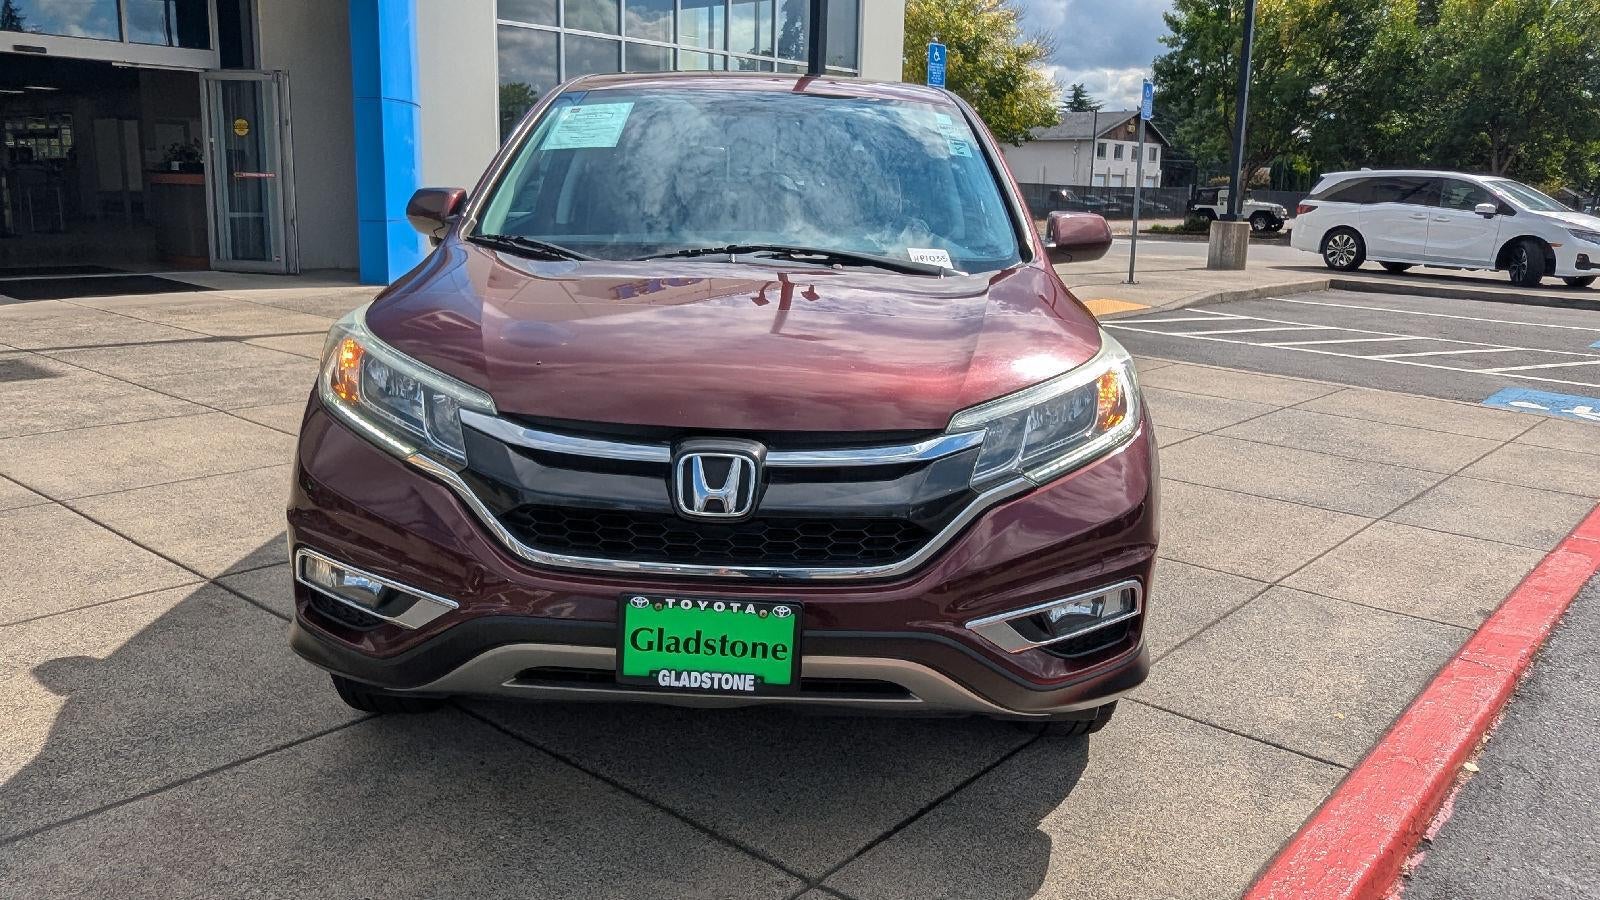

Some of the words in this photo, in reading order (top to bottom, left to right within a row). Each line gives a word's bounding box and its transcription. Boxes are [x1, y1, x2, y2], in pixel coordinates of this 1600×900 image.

[665, 598, 757, 615] TOYOTA
[630, 627, 788, 661] Gladstone
[658, 669, 755, 692] GLADSTONE
